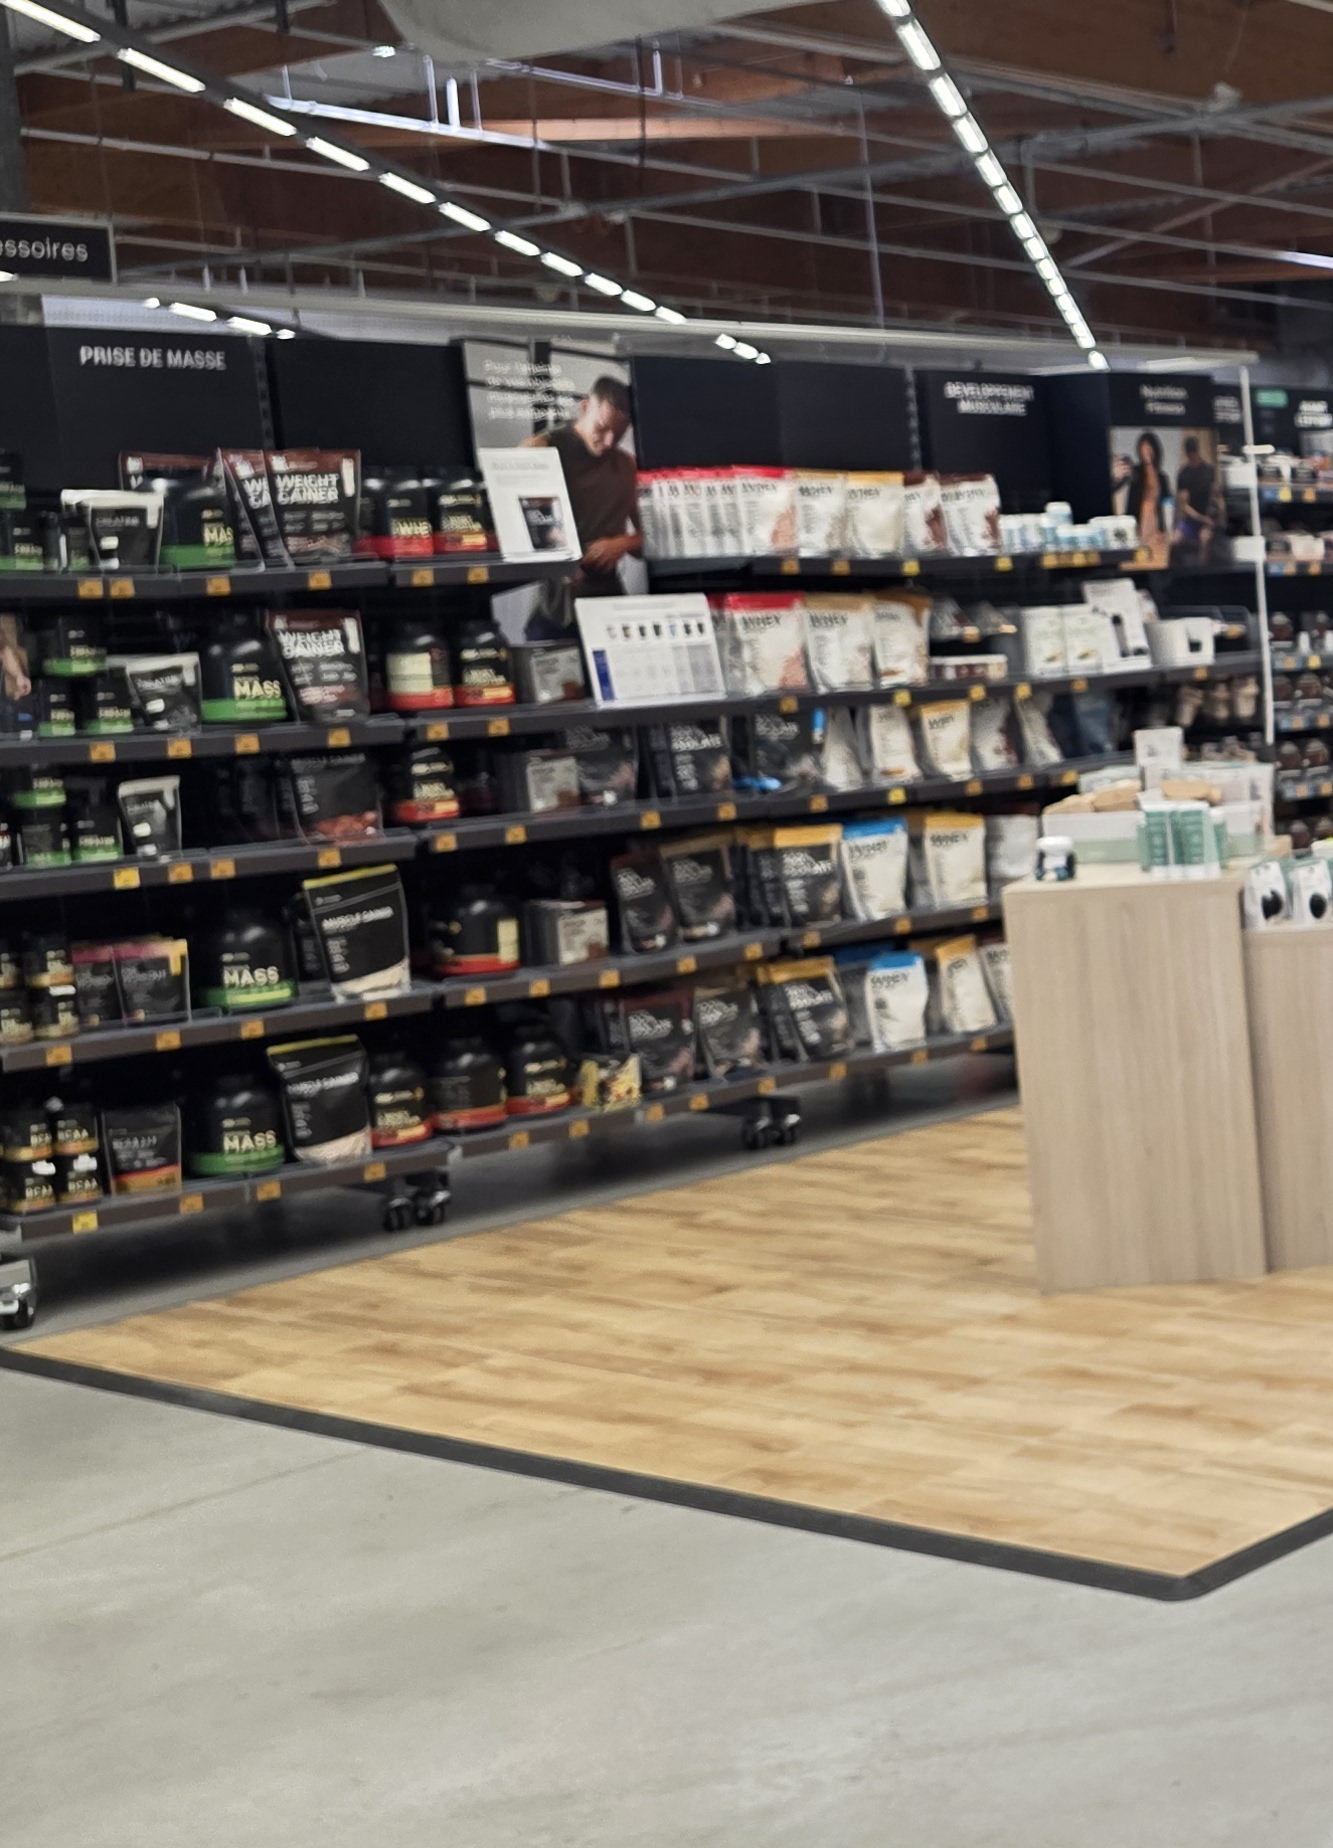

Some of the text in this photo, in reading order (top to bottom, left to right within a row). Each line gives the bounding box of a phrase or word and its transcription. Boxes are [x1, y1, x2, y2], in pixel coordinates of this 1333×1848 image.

[79, 345, 227, 371] PRISE DE MASSE
[275, 473, 339, 489] WEIGHT
[203, 527, 235, 545] MAS
[233, 679, 282, 701] MASS
[223, 966, 280, 988] MASS
[223, 1131, 277, 1155] MASS
